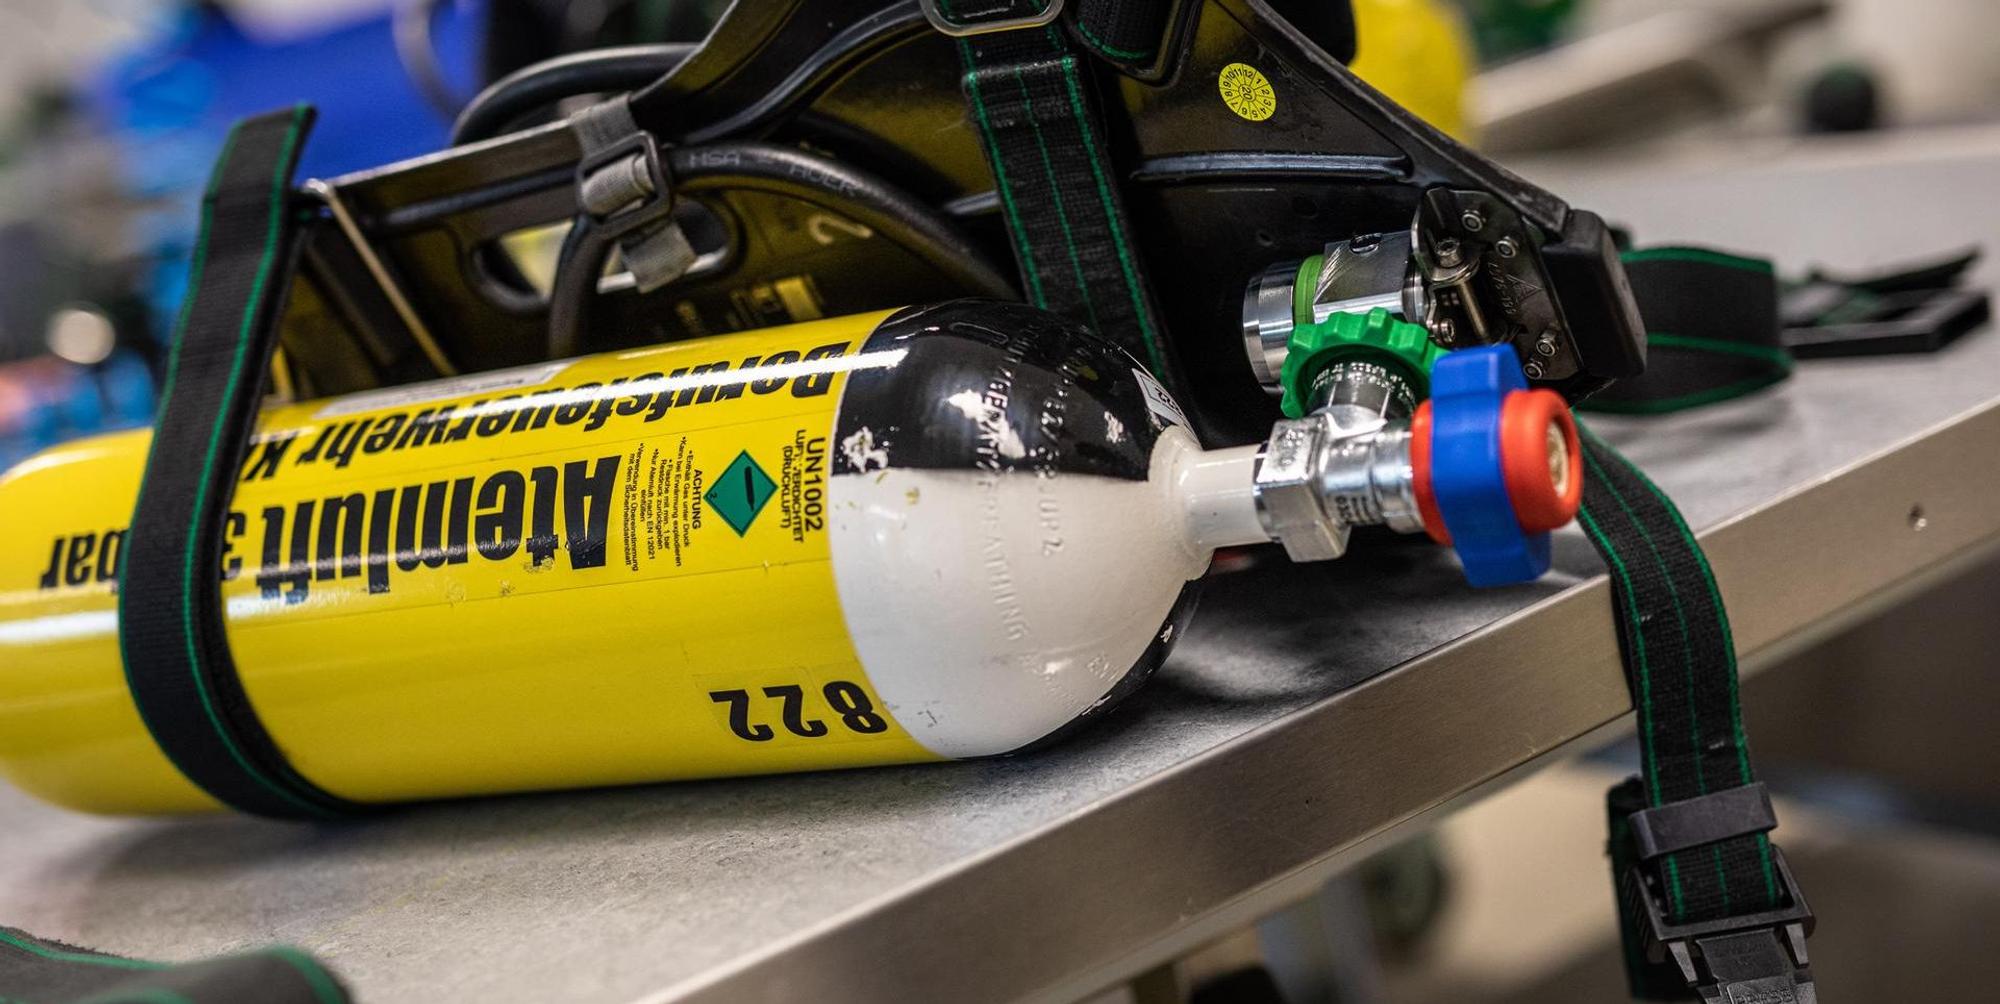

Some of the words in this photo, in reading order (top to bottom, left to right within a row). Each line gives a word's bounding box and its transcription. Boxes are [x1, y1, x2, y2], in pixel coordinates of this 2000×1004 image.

[1242, 86, 1253, 100] 20
[651, 451, 660, 464] Nur
[678, 440, 687, 462] Kann
[626, 466, 634, 482] dem
[630, 447, 643, 491] Verwendung
[656, 459, 667, 497] Restdruck
[664, 464, 672, 495] Flasche
[676, 461, 684, 473] bei
[683, 483, 691, 499] Gas
[692, 469, 703, 529] ACHTUNG
[779, 446, 793, 529] (DRUCKLUFT)
[804, 437, 826, 532] UN1002
[256, 455, 621, 604] Atemluft
[647, 520, 654, 533] EN
[683, 523, 691, 547] Druck
[673, 520, 682, 566] explodieren
[709, 680, 888, 742] 822
